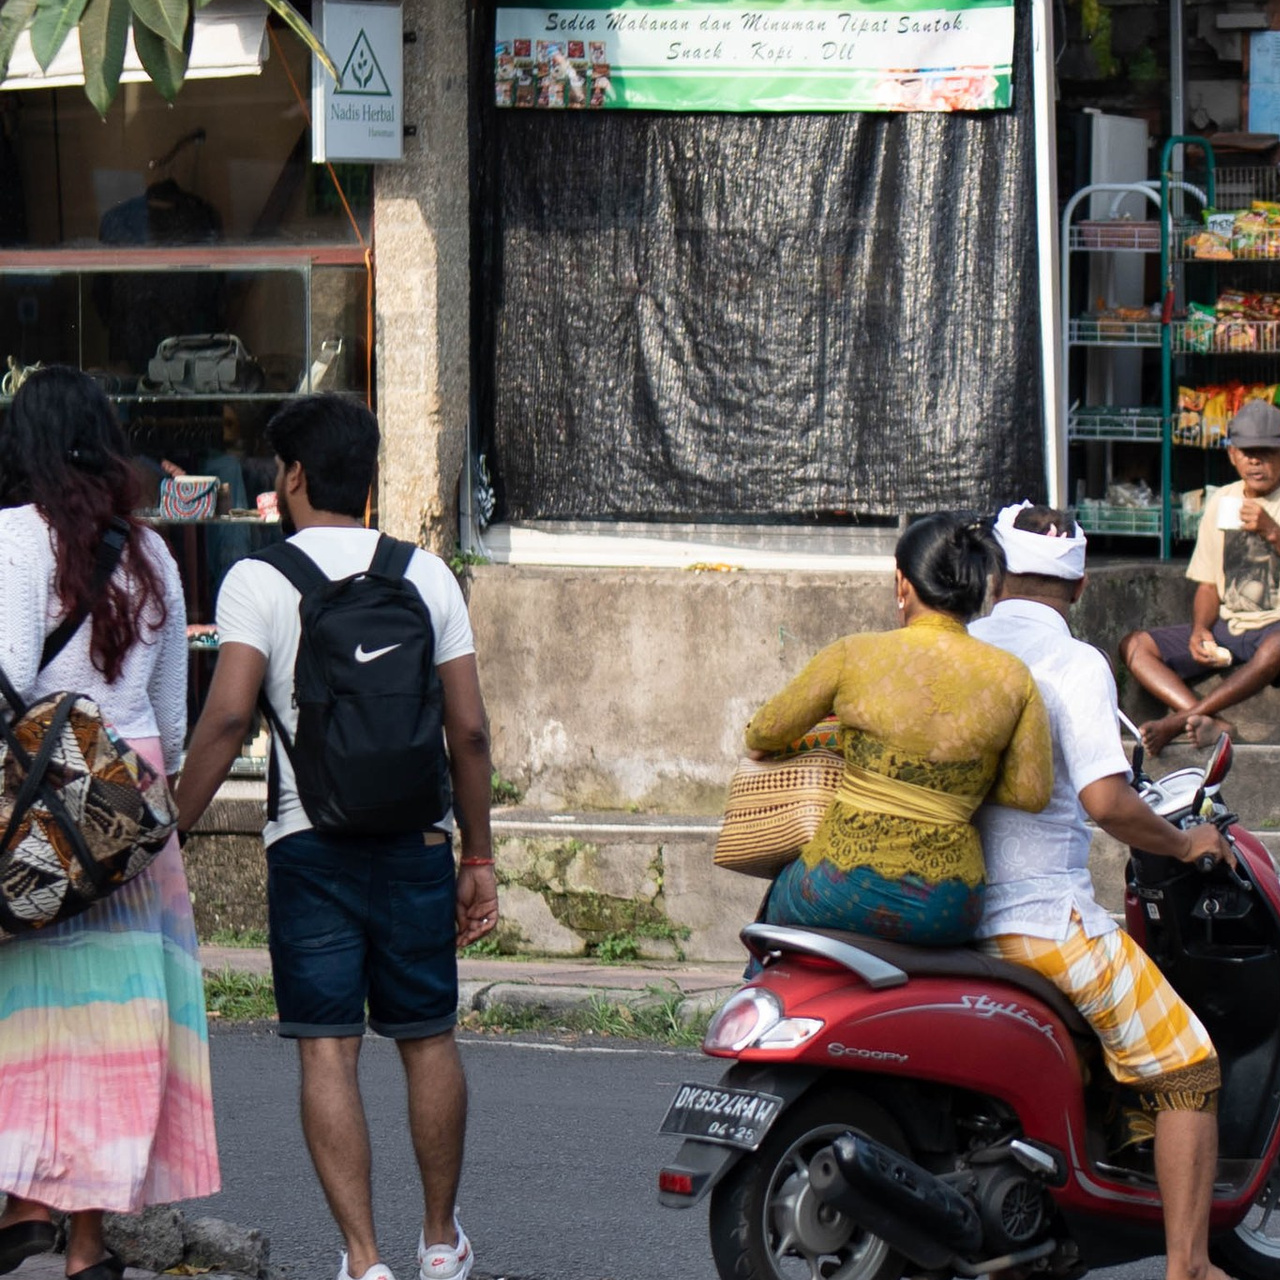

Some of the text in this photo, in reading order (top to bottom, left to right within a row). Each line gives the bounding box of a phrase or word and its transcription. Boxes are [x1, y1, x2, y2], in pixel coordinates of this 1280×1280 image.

[545, 12, 596, 31] Sedia
[605, 13, 691, 31] Makanan
[699, 14, 731, 31] dan
[741, 13, 826, 31] Minuman
[838, 13, 887, 34] Tipat
[666, 42, 854, 64] Snack Kopi Dll
[331, 103, 395, 123] Nadis Herbal
